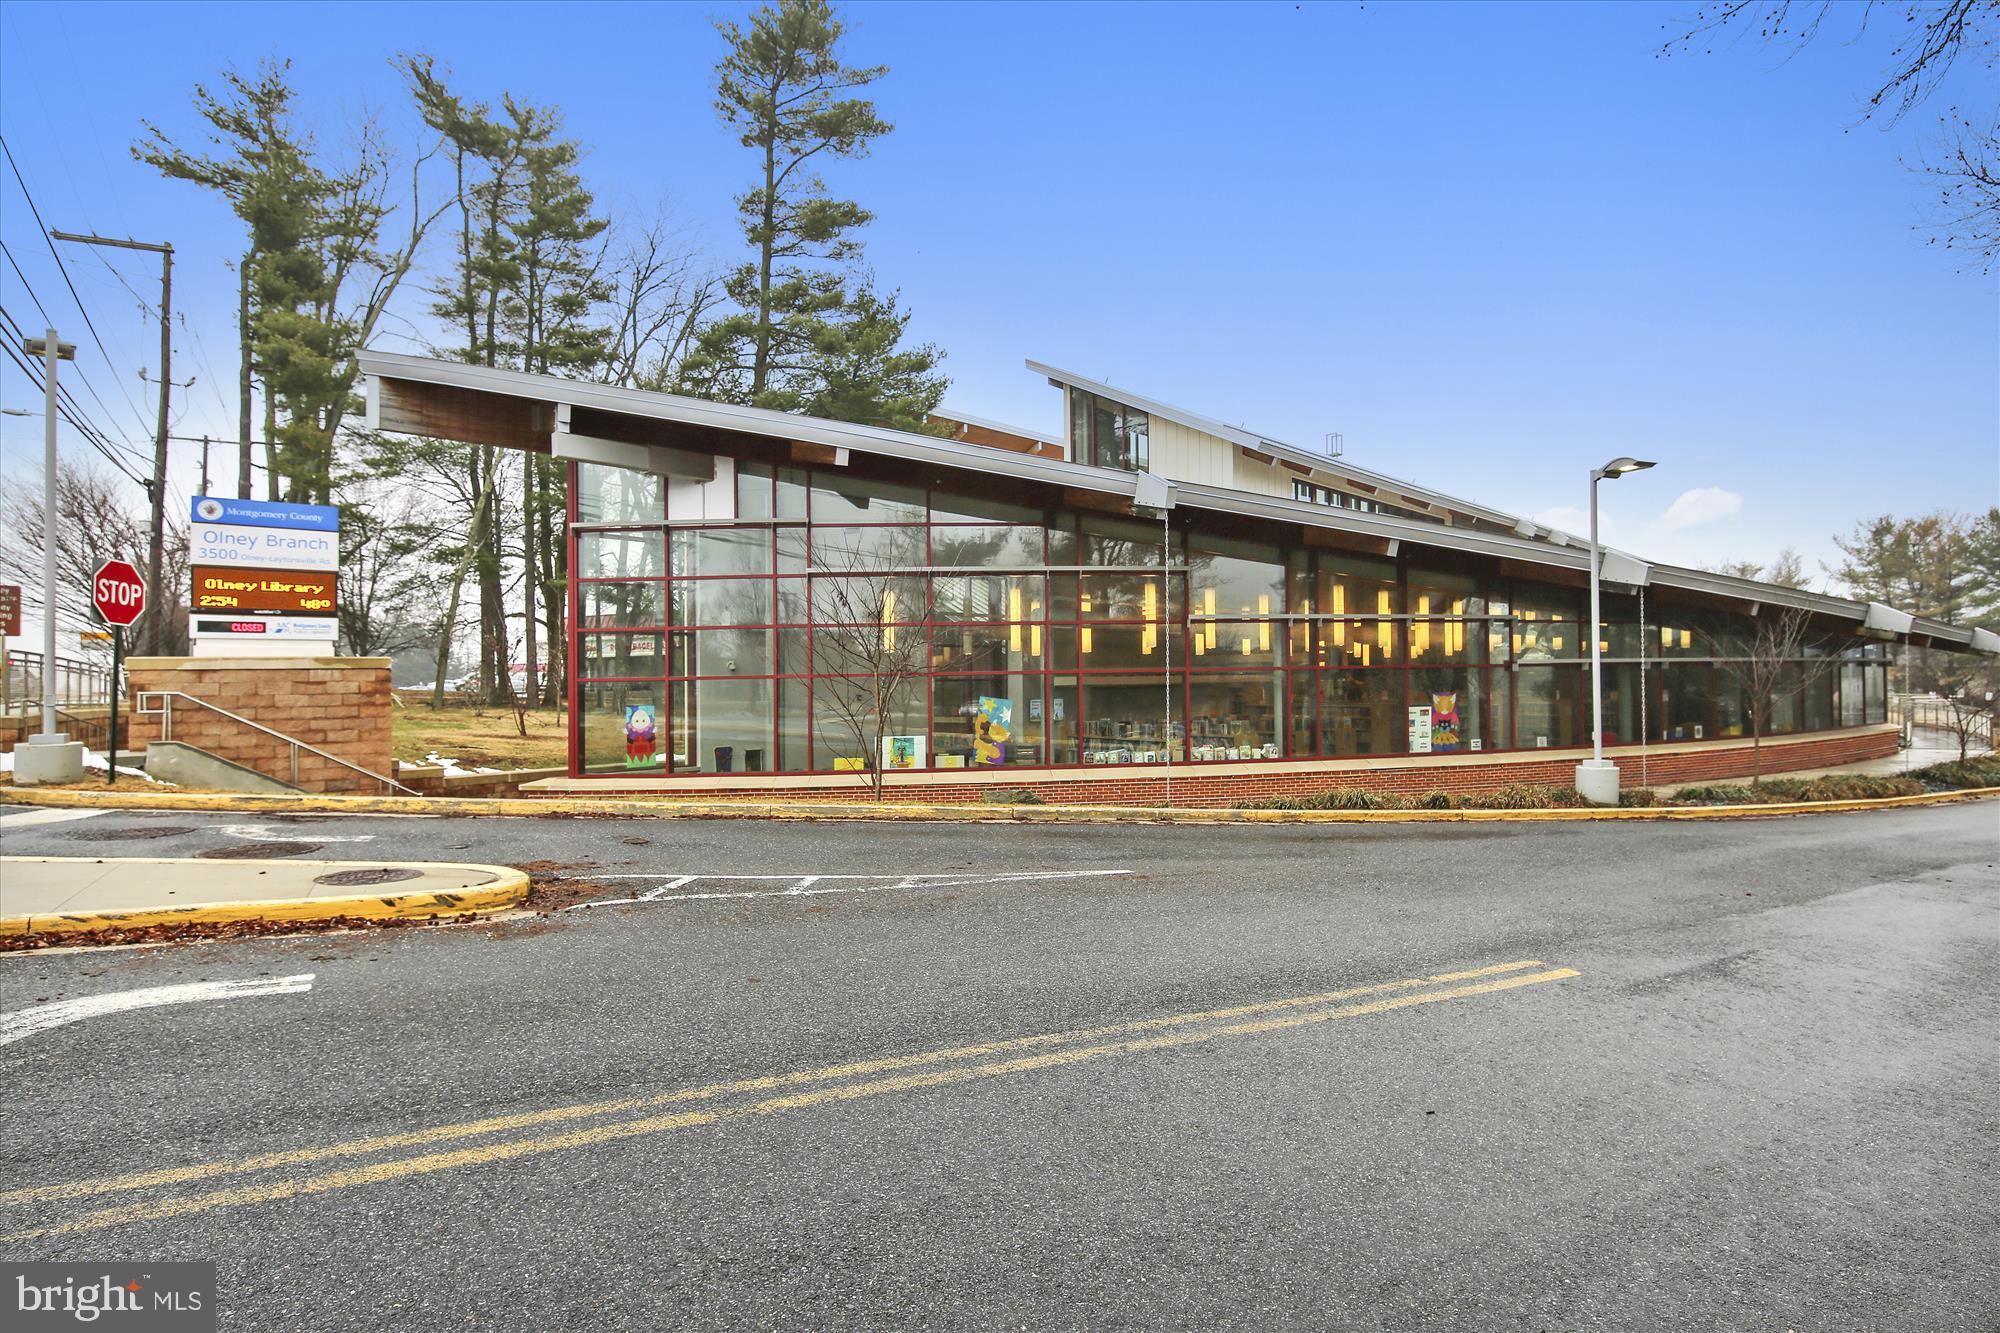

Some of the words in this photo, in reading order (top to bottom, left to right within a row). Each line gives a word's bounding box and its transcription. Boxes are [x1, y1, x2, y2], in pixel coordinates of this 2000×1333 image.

[227, 507, 288, 520] Montgomery
[290, 512, 324, 523] County
[203, 530, 258, 550] Olney
[266, 534, 329, 550] Branch
[199, 547, 238, 560] 3500
[98, 578, 142, 607] STOP
[204, 578, 258, 592] Olney
[260, 581, 324, 594] Library
[200, 595, 238, 607] 2:54
[231, 622, 264, 632] CLOSED
